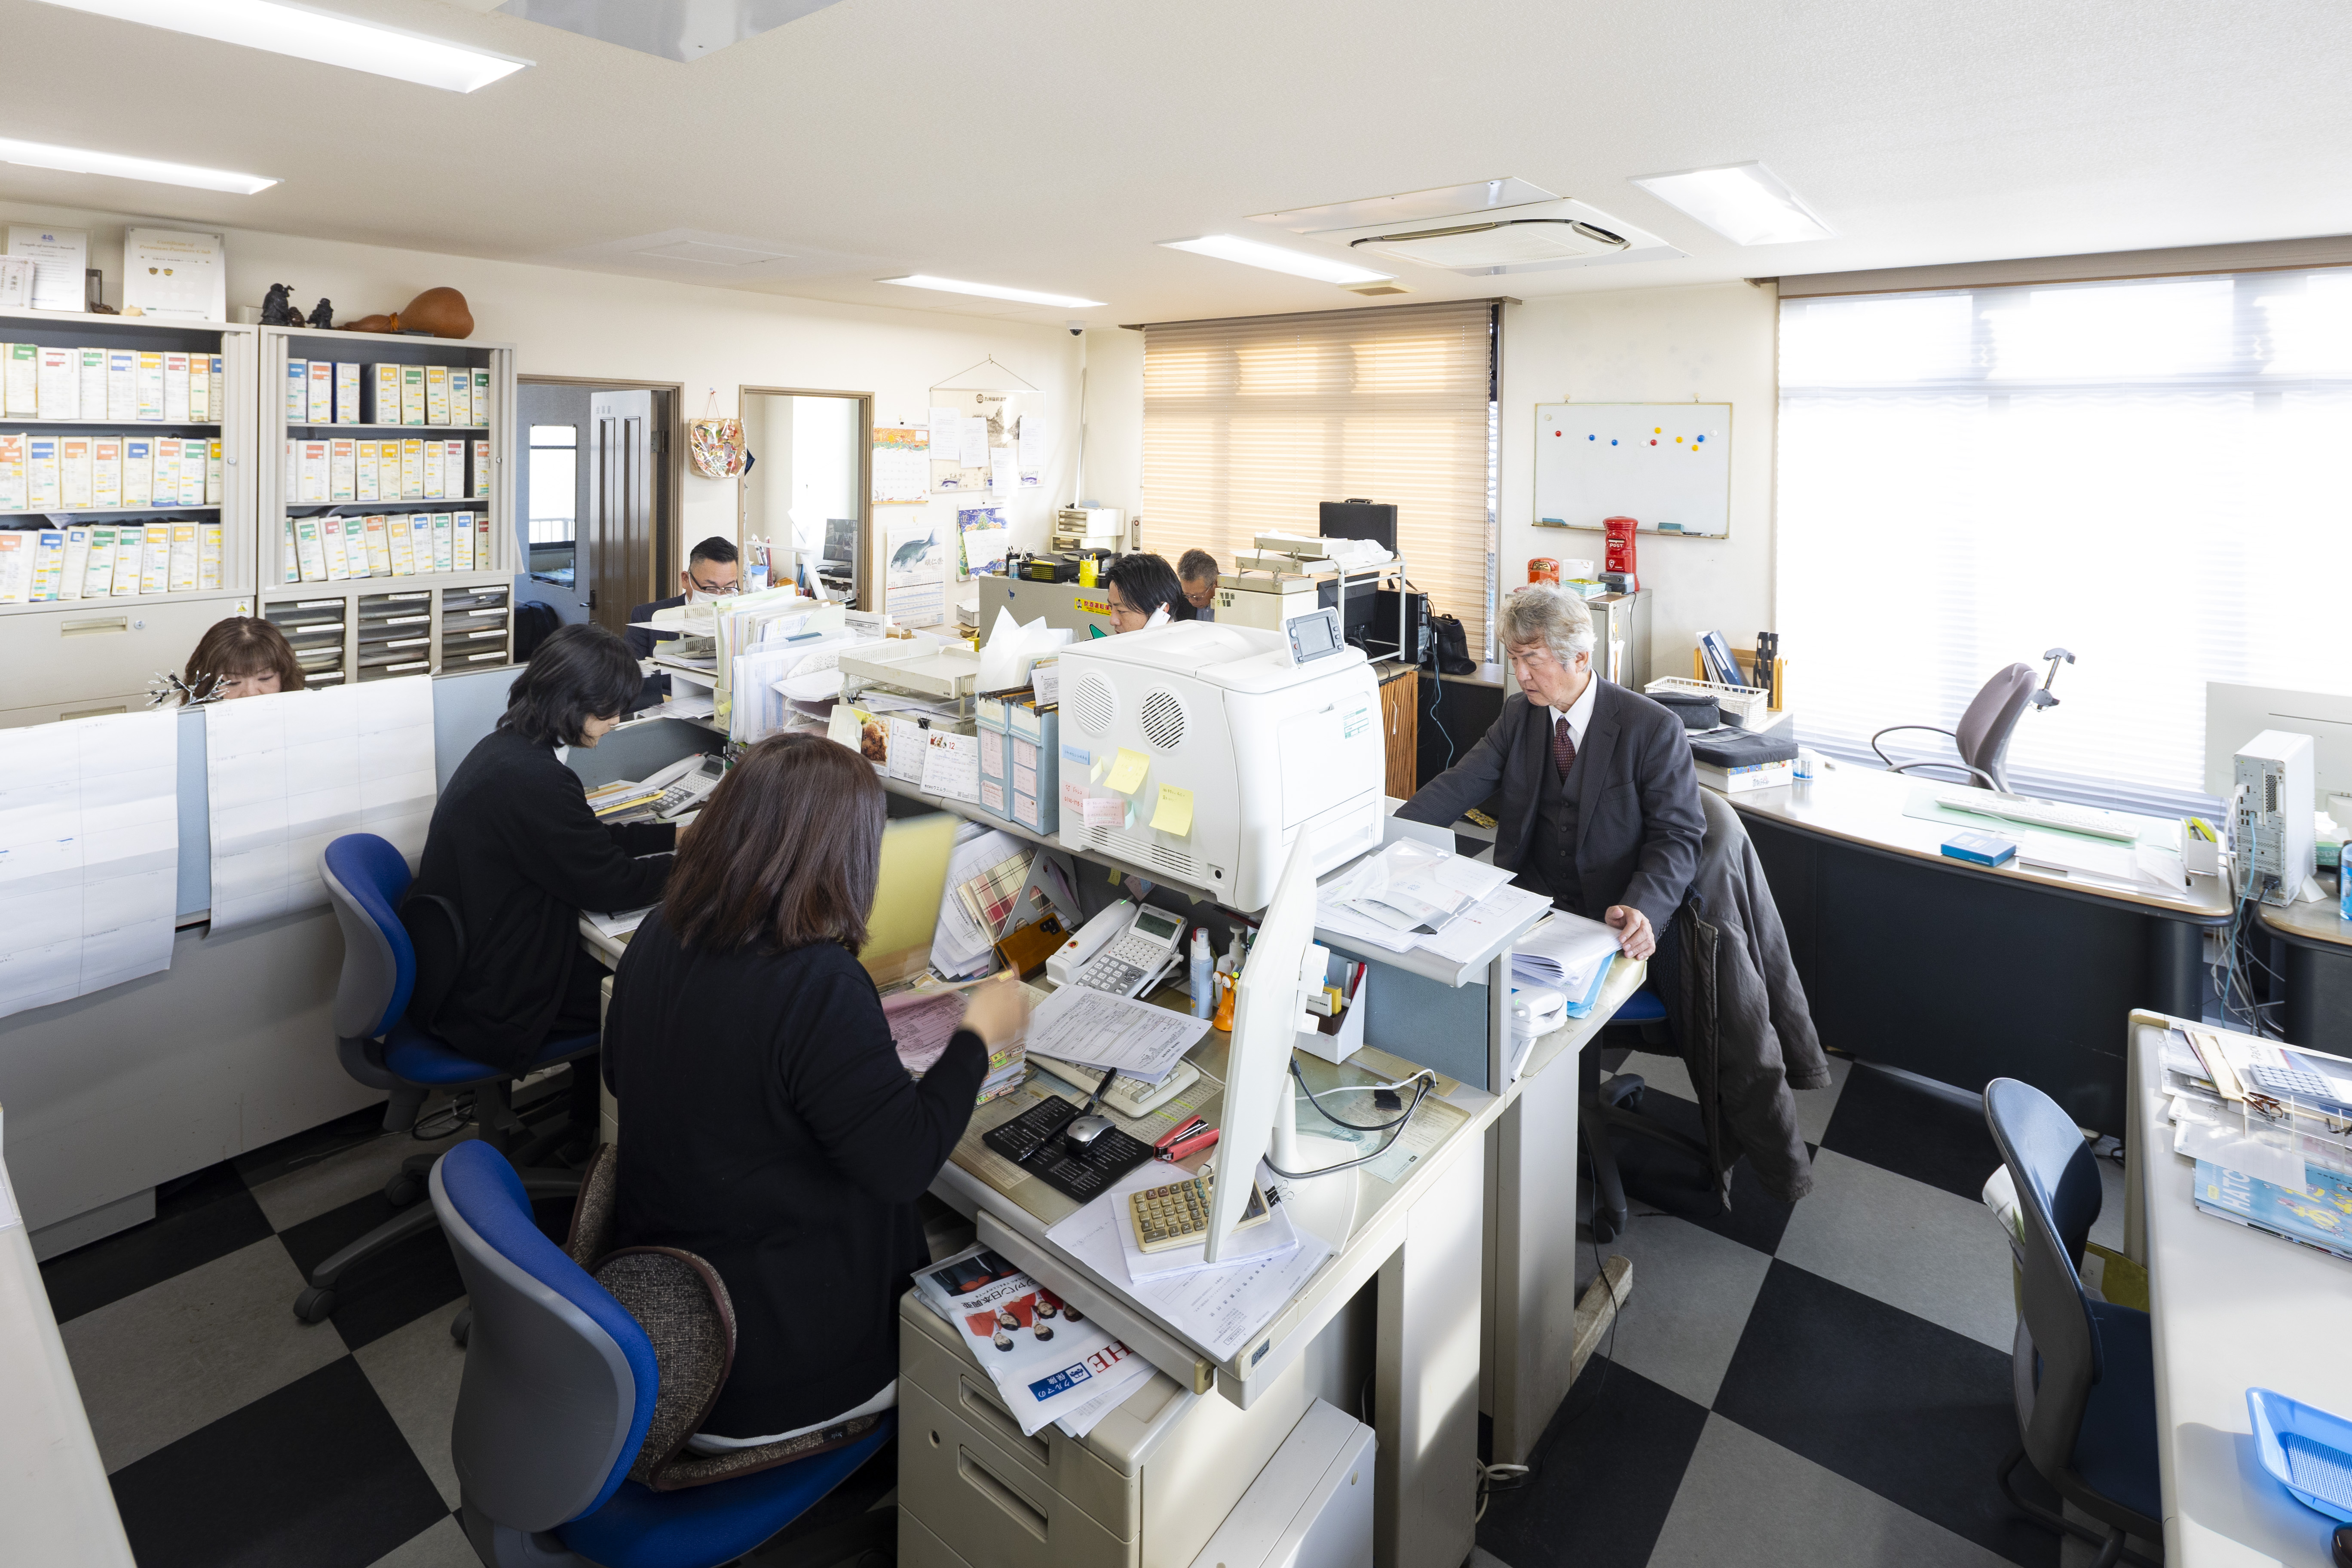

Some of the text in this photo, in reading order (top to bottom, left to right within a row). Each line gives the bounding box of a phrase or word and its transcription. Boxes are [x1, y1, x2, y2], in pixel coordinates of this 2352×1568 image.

[1047, 1372, 1066, 1385] 保険
[1038, 1378, 1070, 1398] クルマの
